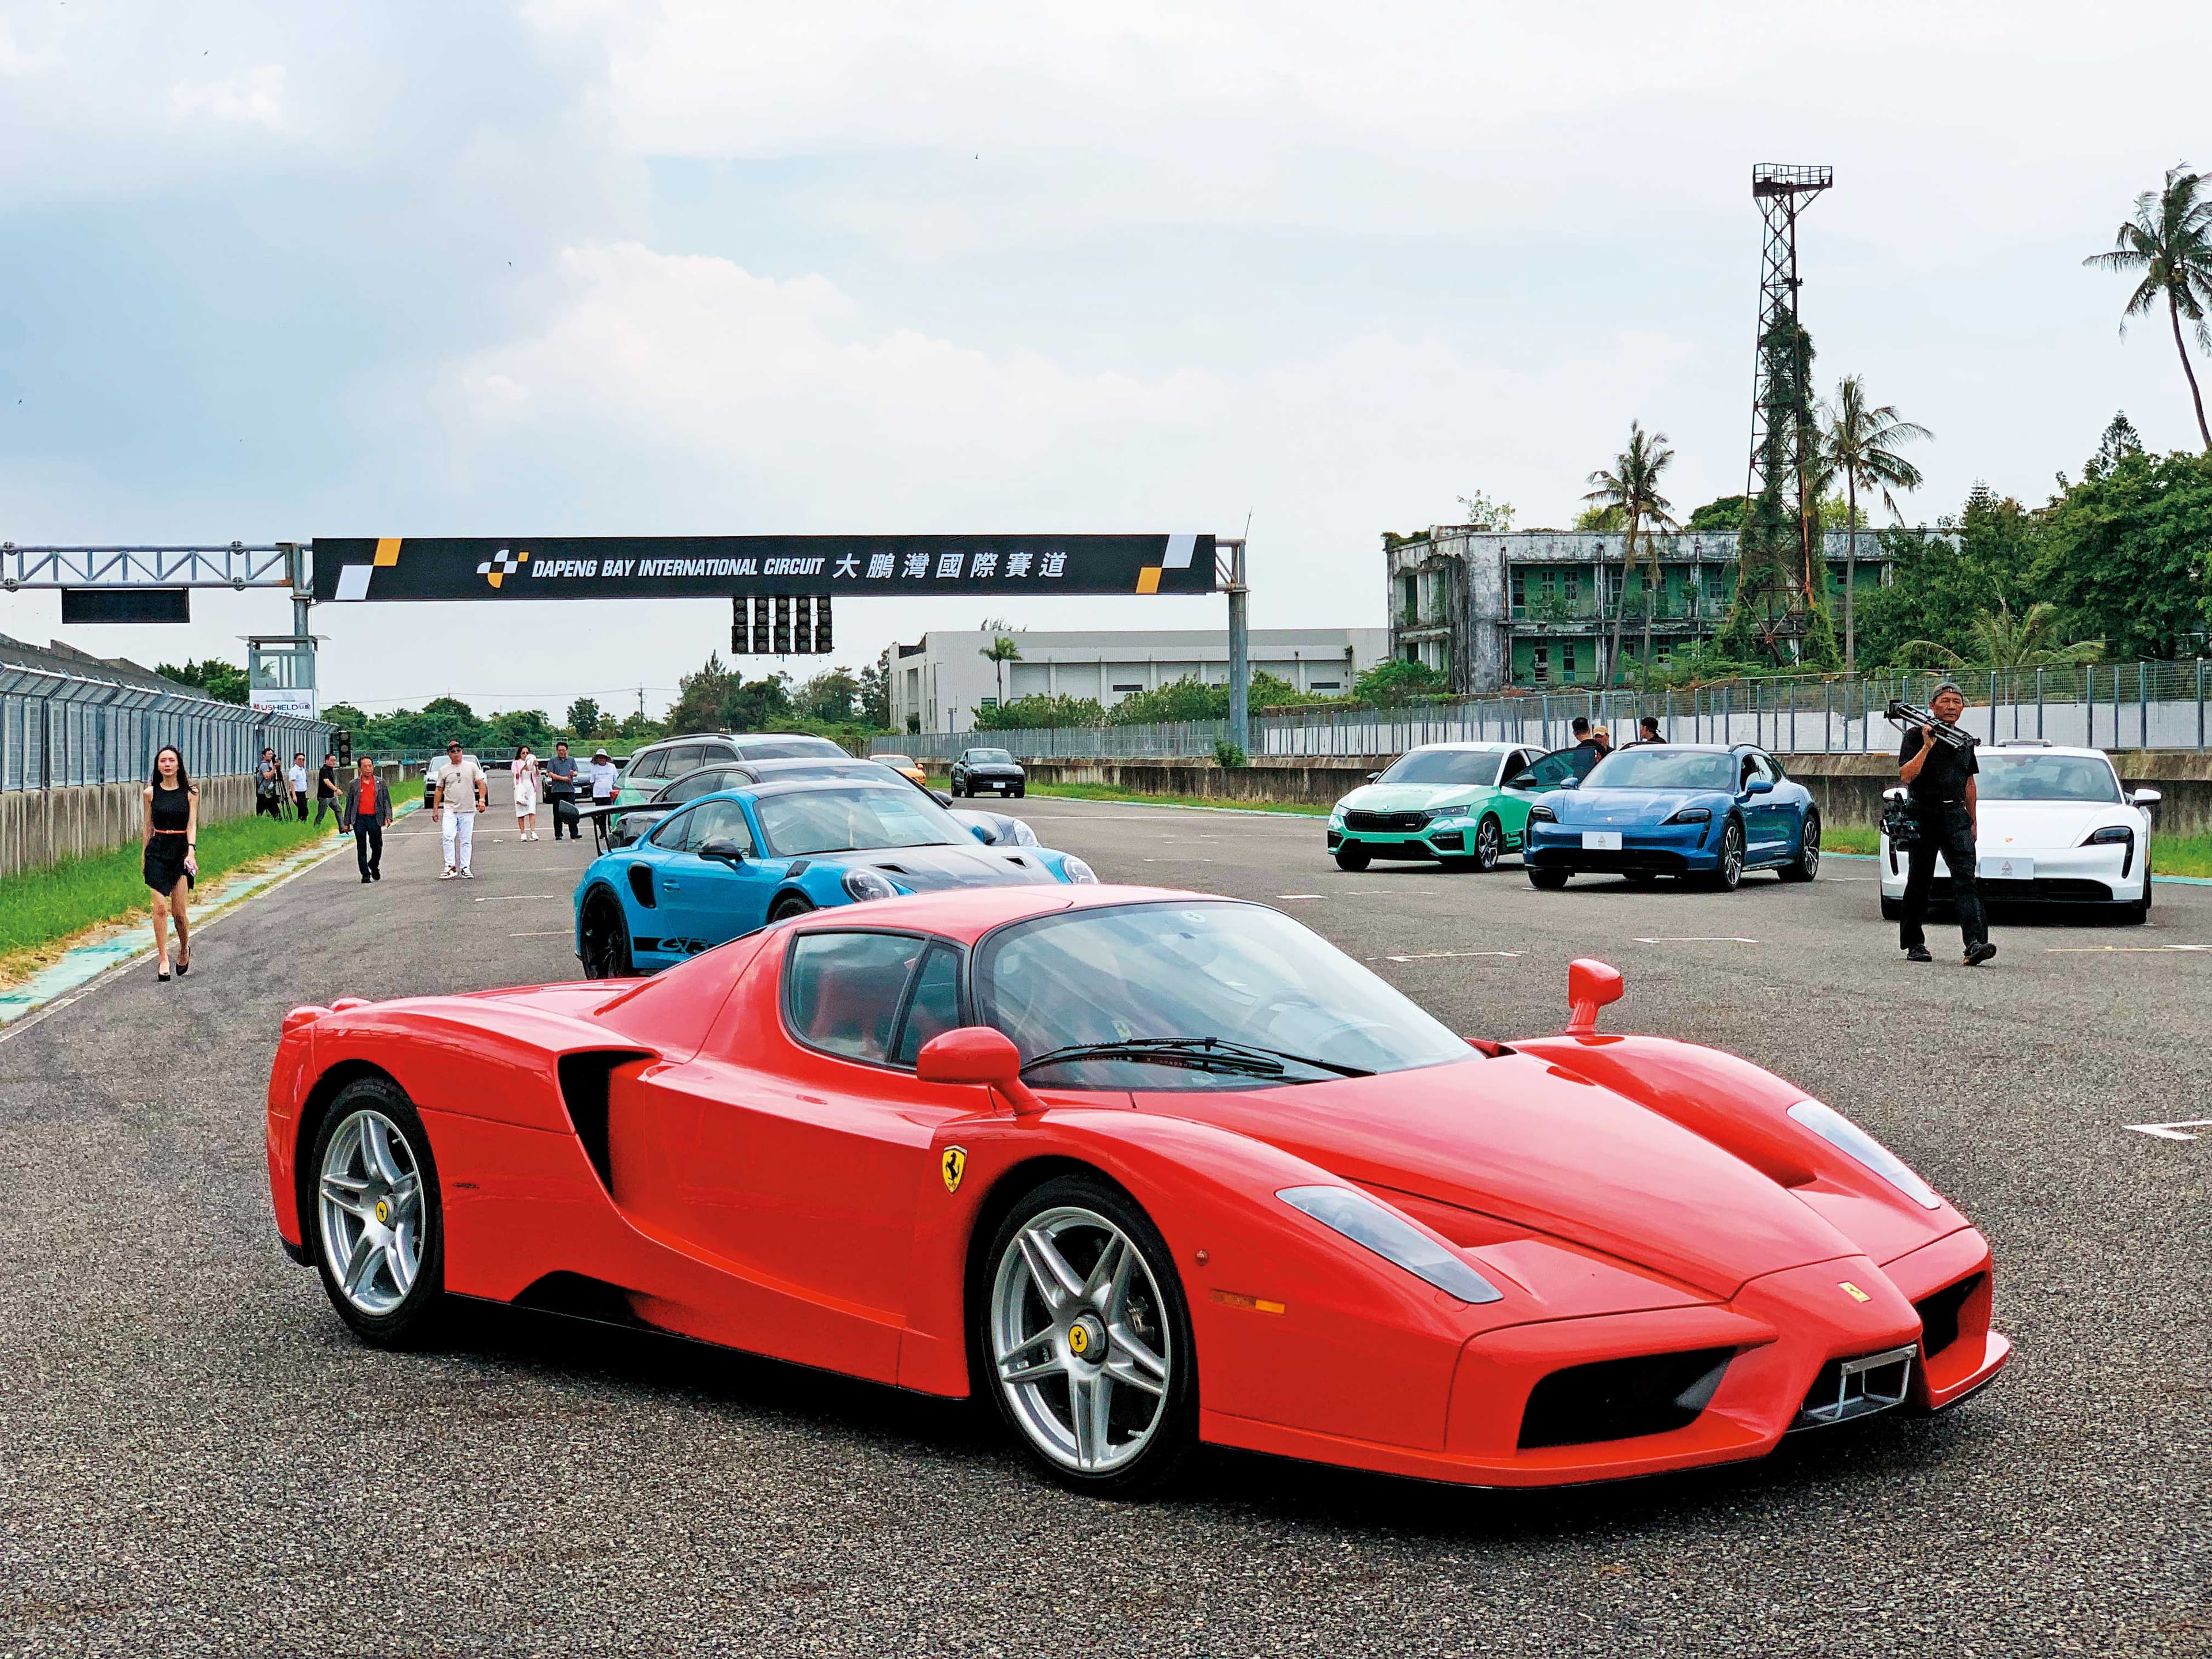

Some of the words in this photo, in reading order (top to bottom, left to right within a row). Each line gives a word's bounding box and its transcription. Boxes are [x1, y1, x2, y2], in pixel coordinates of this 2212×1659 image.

[531, 559, 598, 577] DAPENG
[601, 559, 636, 577] BAY
[638, 558, 758, 577] INTERNATIONAL
[763, 558, 825, 575] CIRCUIT
[831, 552, 1067, 579] 大鵬灣國際賽道
